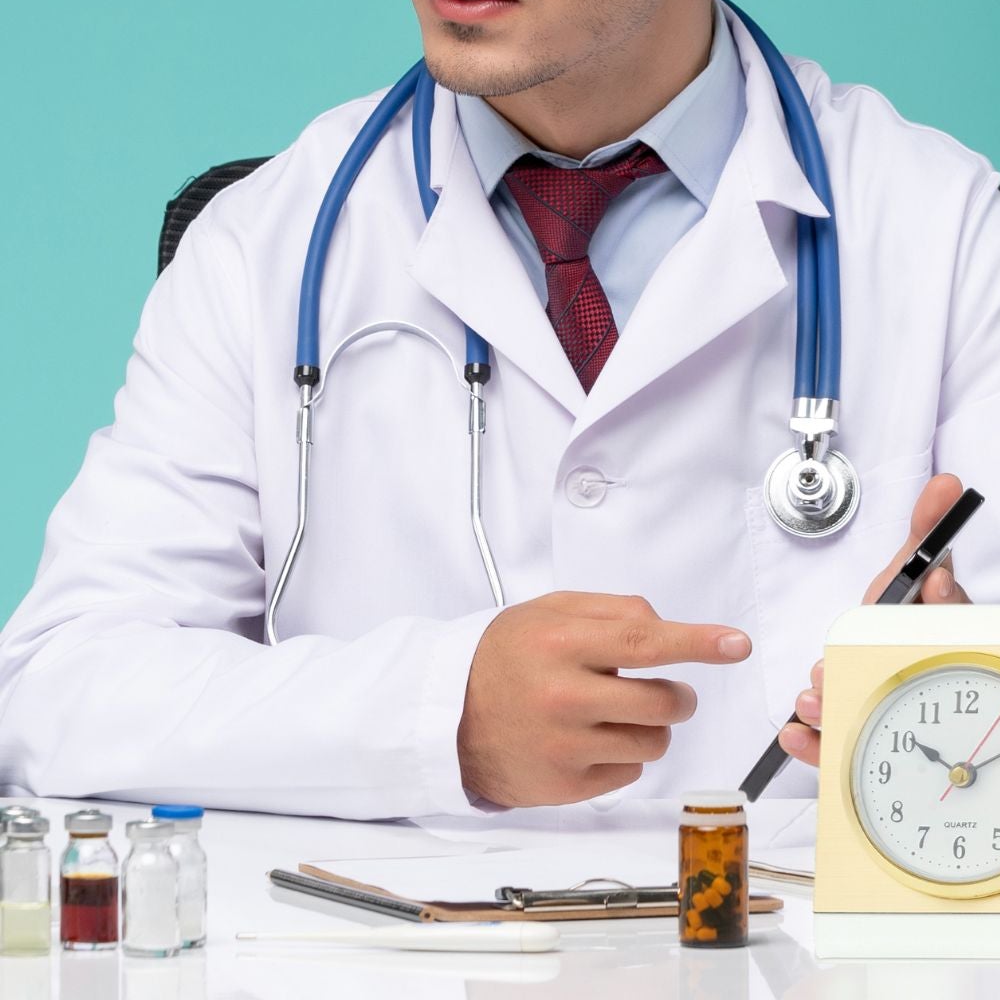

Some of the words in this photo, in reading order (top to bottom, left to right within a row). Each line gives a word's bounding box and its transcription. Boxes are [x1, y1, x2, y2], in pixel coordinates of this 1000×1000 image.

[918, 702, 941, 724] 11
[953, 690, 979, 714] 12
[890, 731, 915, 752] 10
[878, 761, 892, 784] 9
[890, 800, 904, 822] 8
[943, 821, 977, 829] QUARTZ
[917, 826, 930, 849] 7
[952, 836, 966, 859] 6
